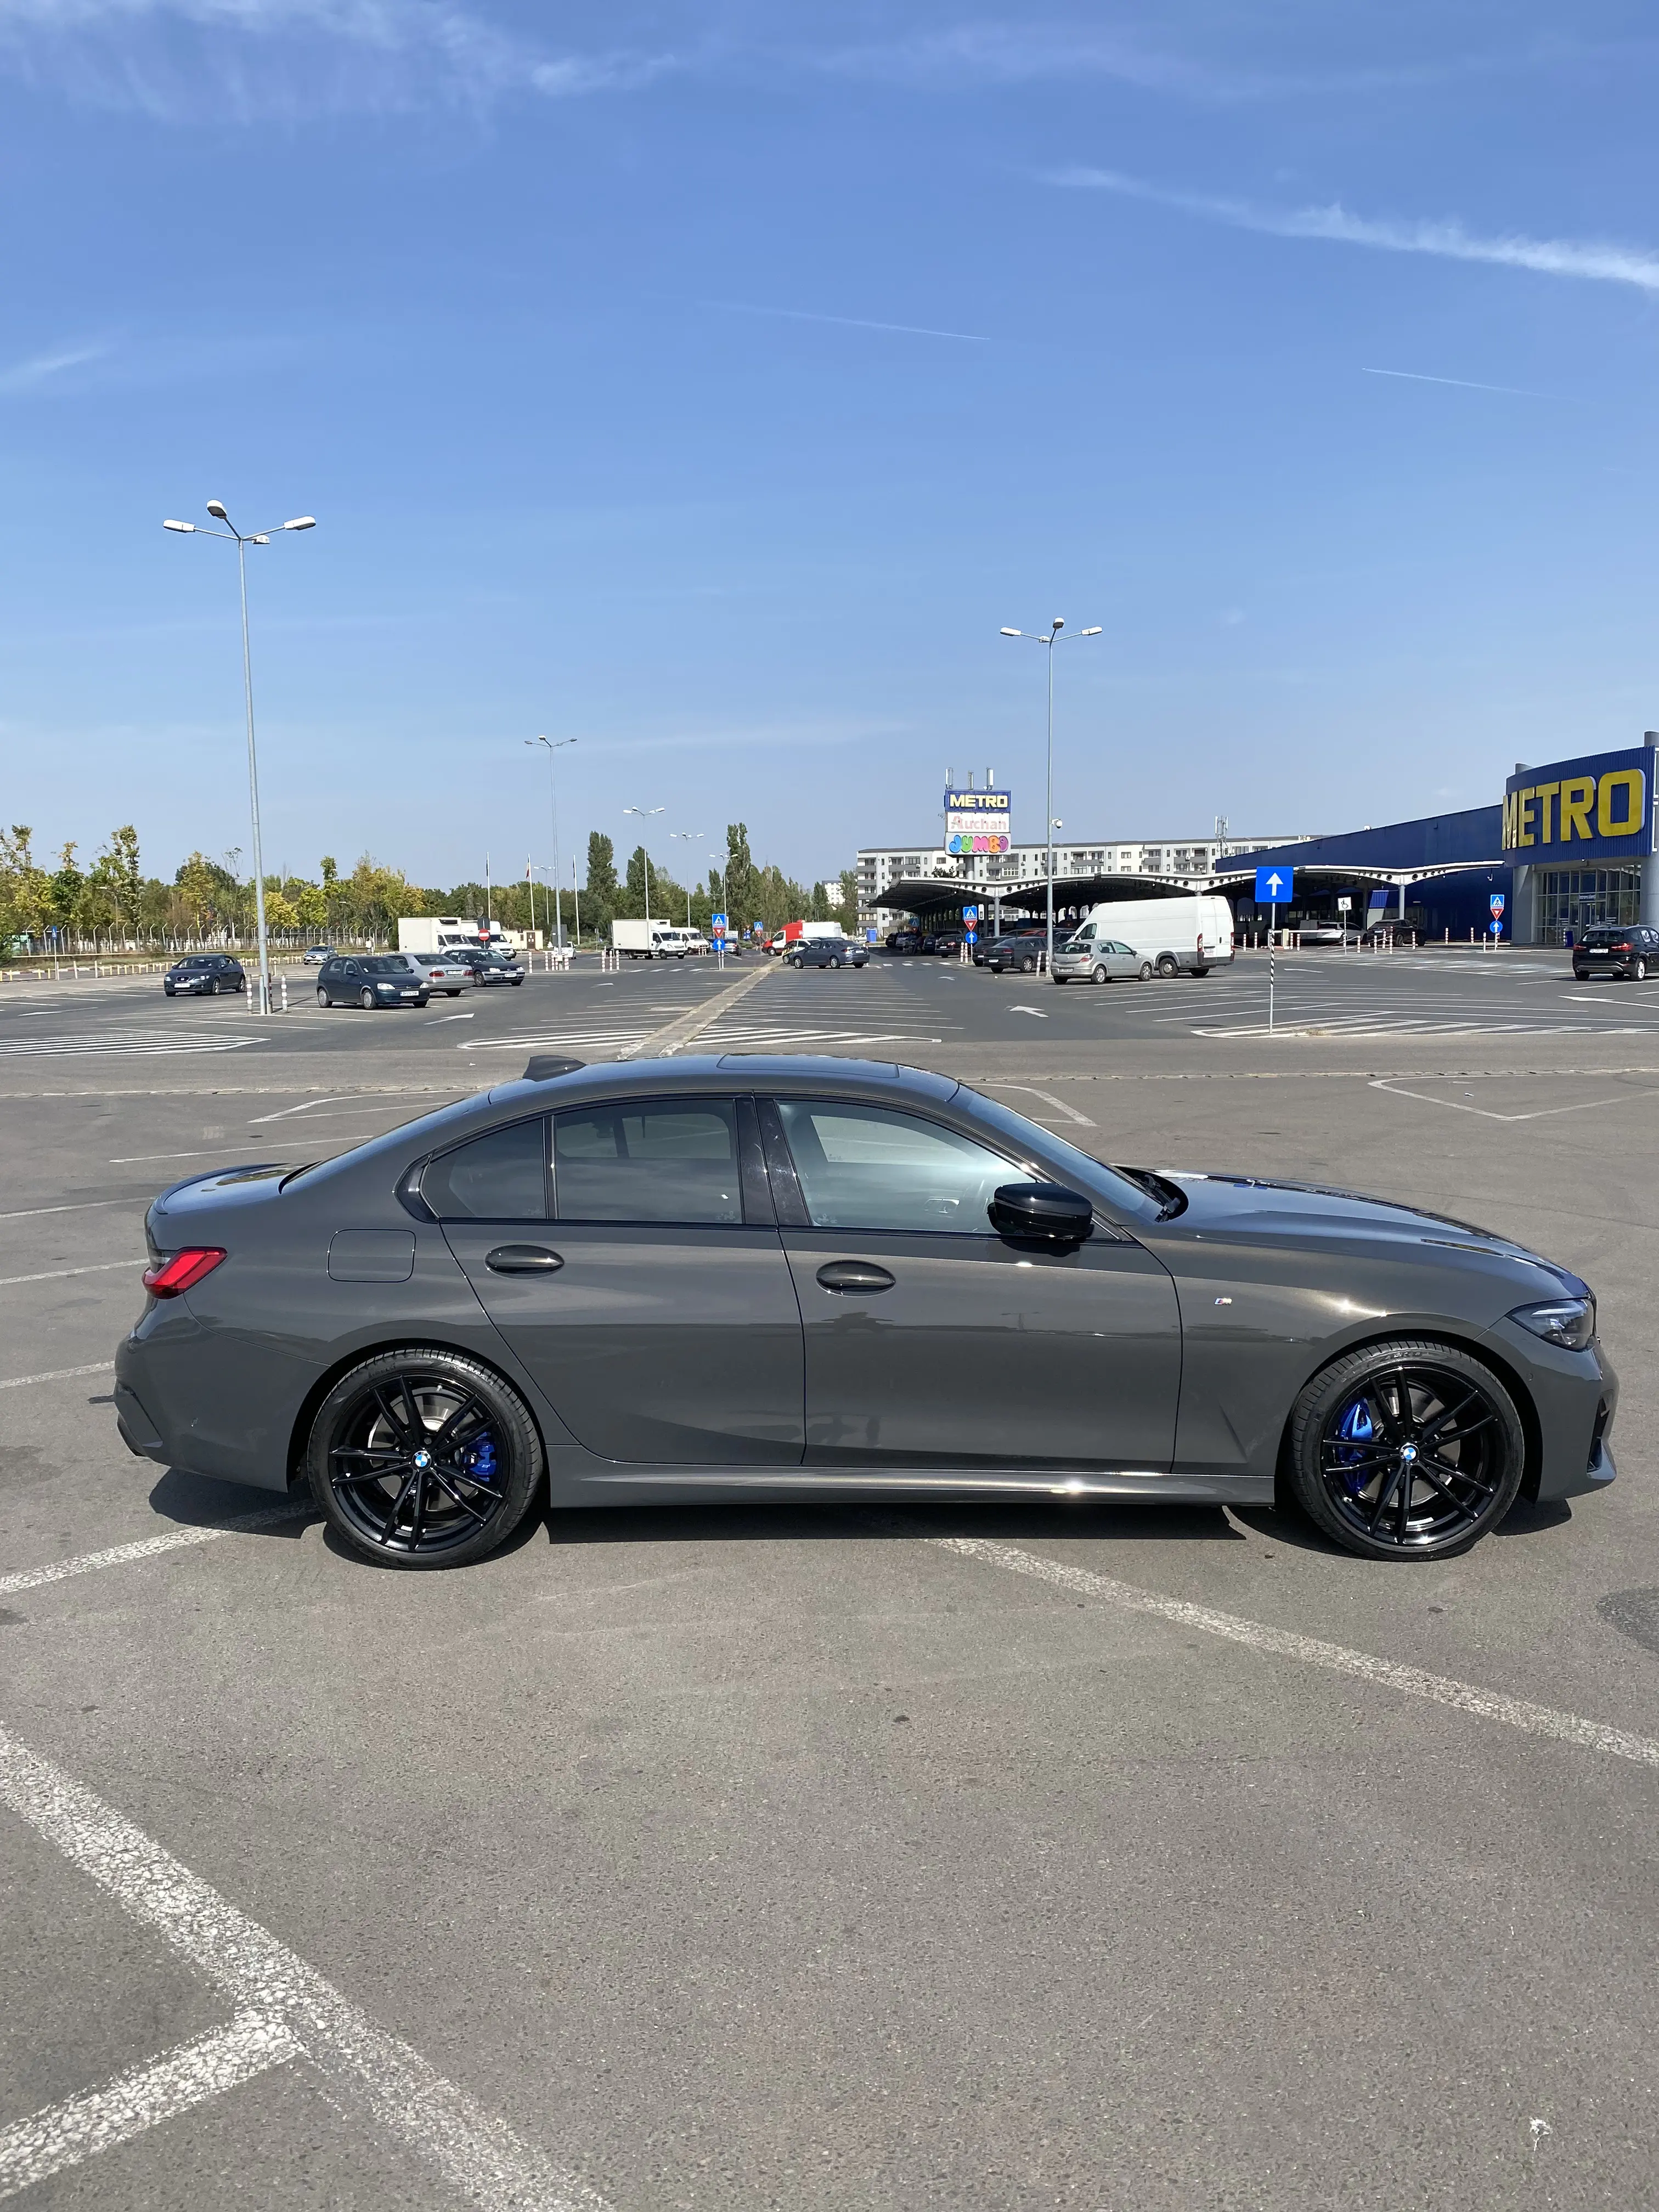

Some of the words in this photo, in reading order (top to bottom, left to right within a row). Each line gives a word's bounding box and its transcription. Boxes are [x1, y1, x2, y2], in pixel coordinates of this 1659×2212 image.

[950, 794, 1008, 808] METRO
[1502, 768, 1644, 851] METRO
[950, 816, 1007, 830] Auchan
[949, 834, 1009, 854] JUMBO
